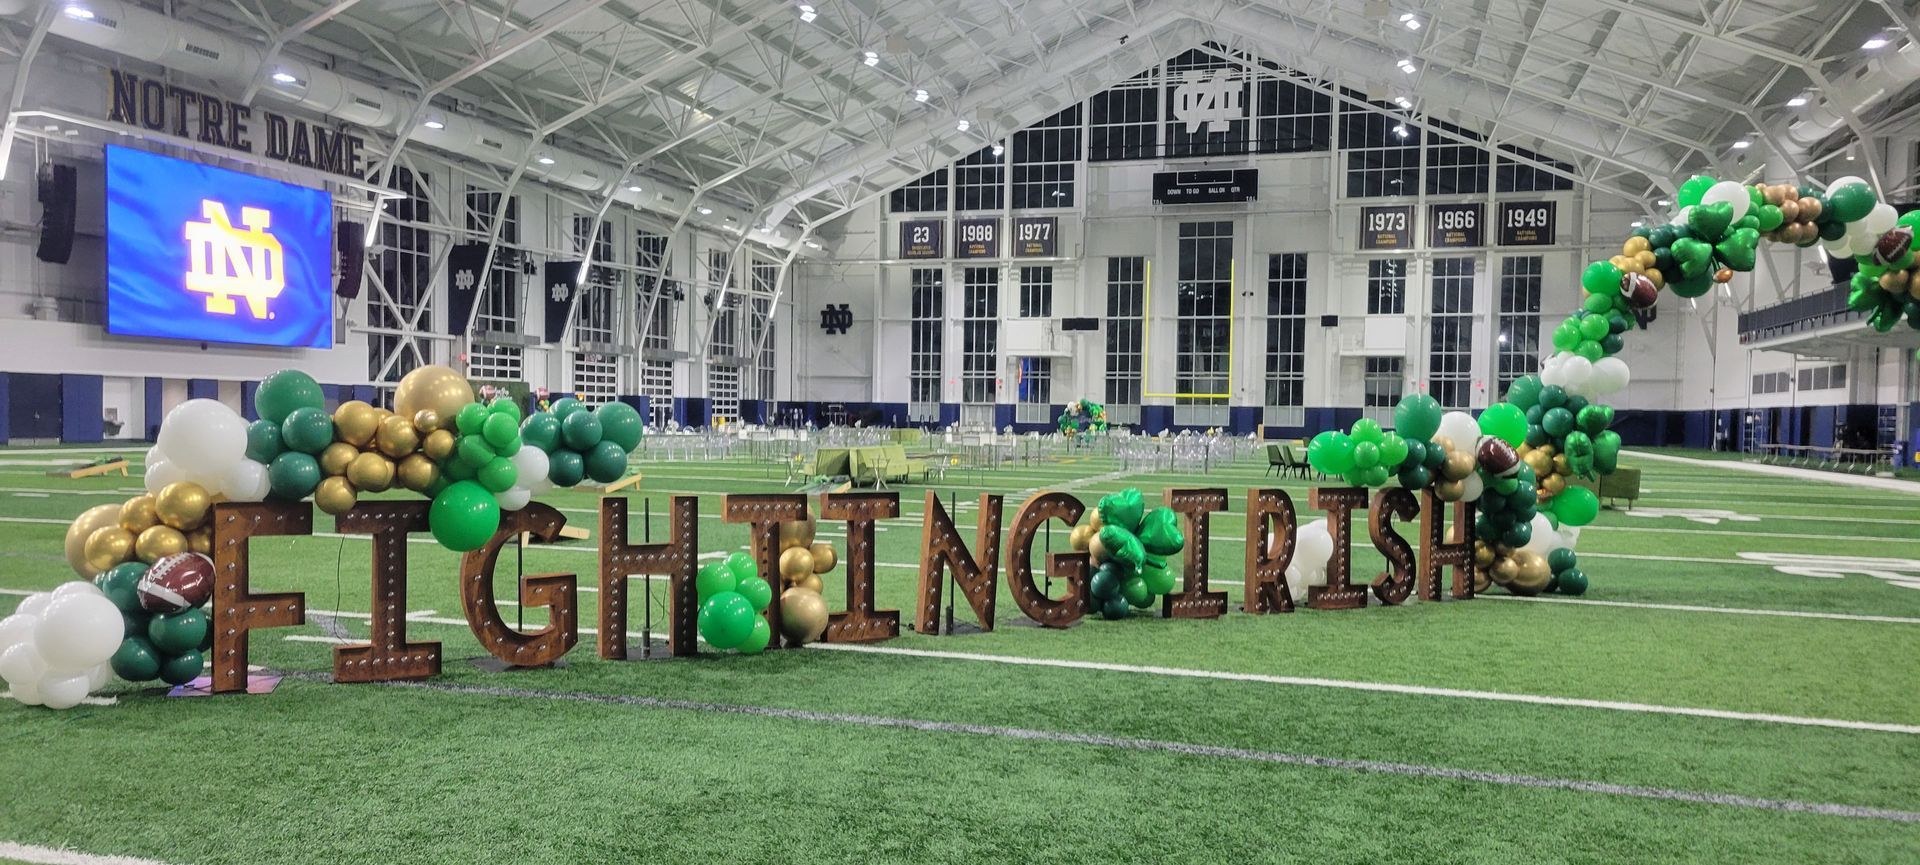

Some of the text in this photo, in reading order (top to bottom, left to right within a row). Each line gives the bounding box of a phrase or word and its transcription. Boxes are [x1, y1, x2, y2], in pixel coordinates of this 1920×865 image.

[108, 68, 365, 180] NOTRE DAME
[1368, 212, 1406, 231] 1973
[1437, 210, 1475, 229] 1966
[1507, 208, 1547, 228] 1949
[913, 226, 929, 243] 23
[962, 225, 993, 242] 1988
[1019, 223, 1051, 241] 1977
[212, 487, 1476, 694] FIGHTING IRISH
